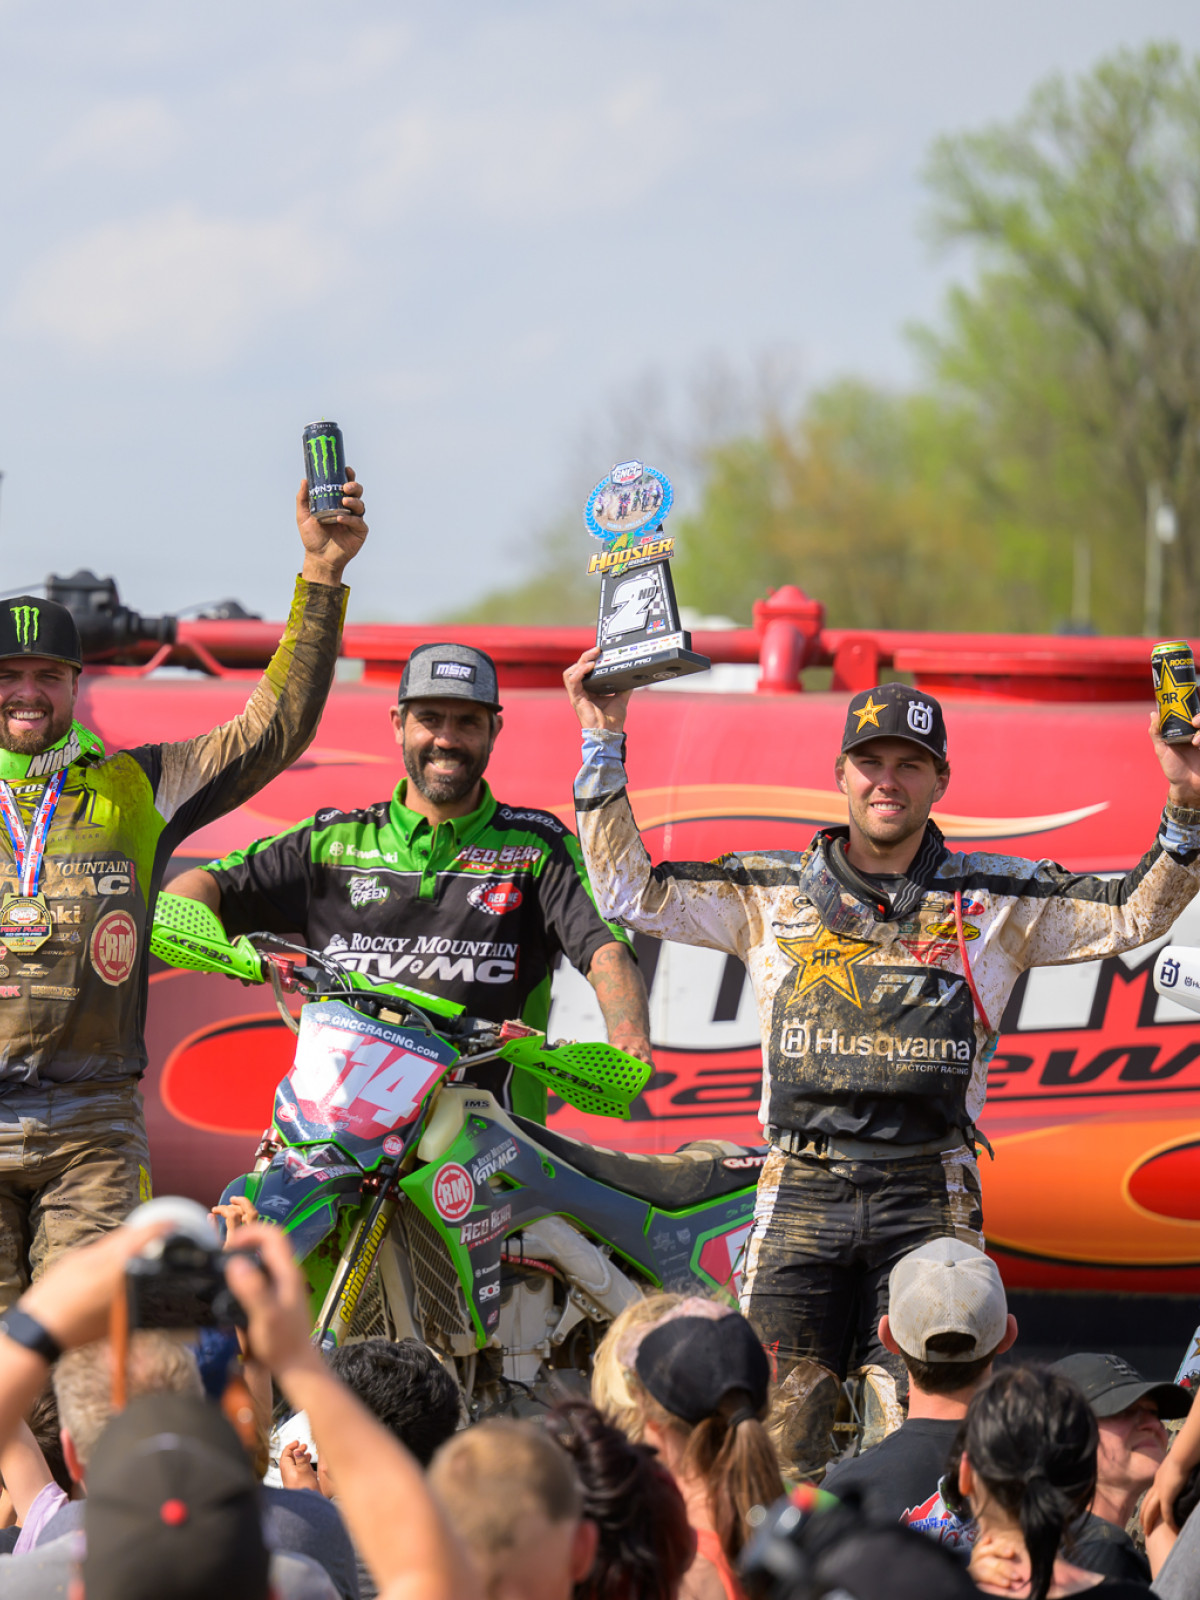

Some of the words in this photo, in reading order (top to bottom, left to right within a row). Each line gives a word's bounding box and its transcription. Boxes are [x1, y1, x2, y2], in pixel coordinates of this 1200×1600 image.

[588, 537, 675, 573] HOOSIER
[435, 662, 472, 679] MSR
[609, 662, 633, 672] OPEN
[634, 656, 652, 666] PRO
[351, 887, 388, 906] GREEN
[350, 932, 411, 953] ROCKY
[411, 935, 518, 959] MOUNTAIN
[331, 1015, 440, 1060] GNCCRACING.COM
[816, 1028, 970, 1062] Husqvarna
[895, 1064, 940, 1074] FACTORY
[940, 1065, 969, 1076] RACING
[464, 1100, 490, 1108] IMS
[460, 1218, 489, 1245] RED
[340, 1212, 388, 1324] connection
[479, 1281, 500, 1301] SOS
